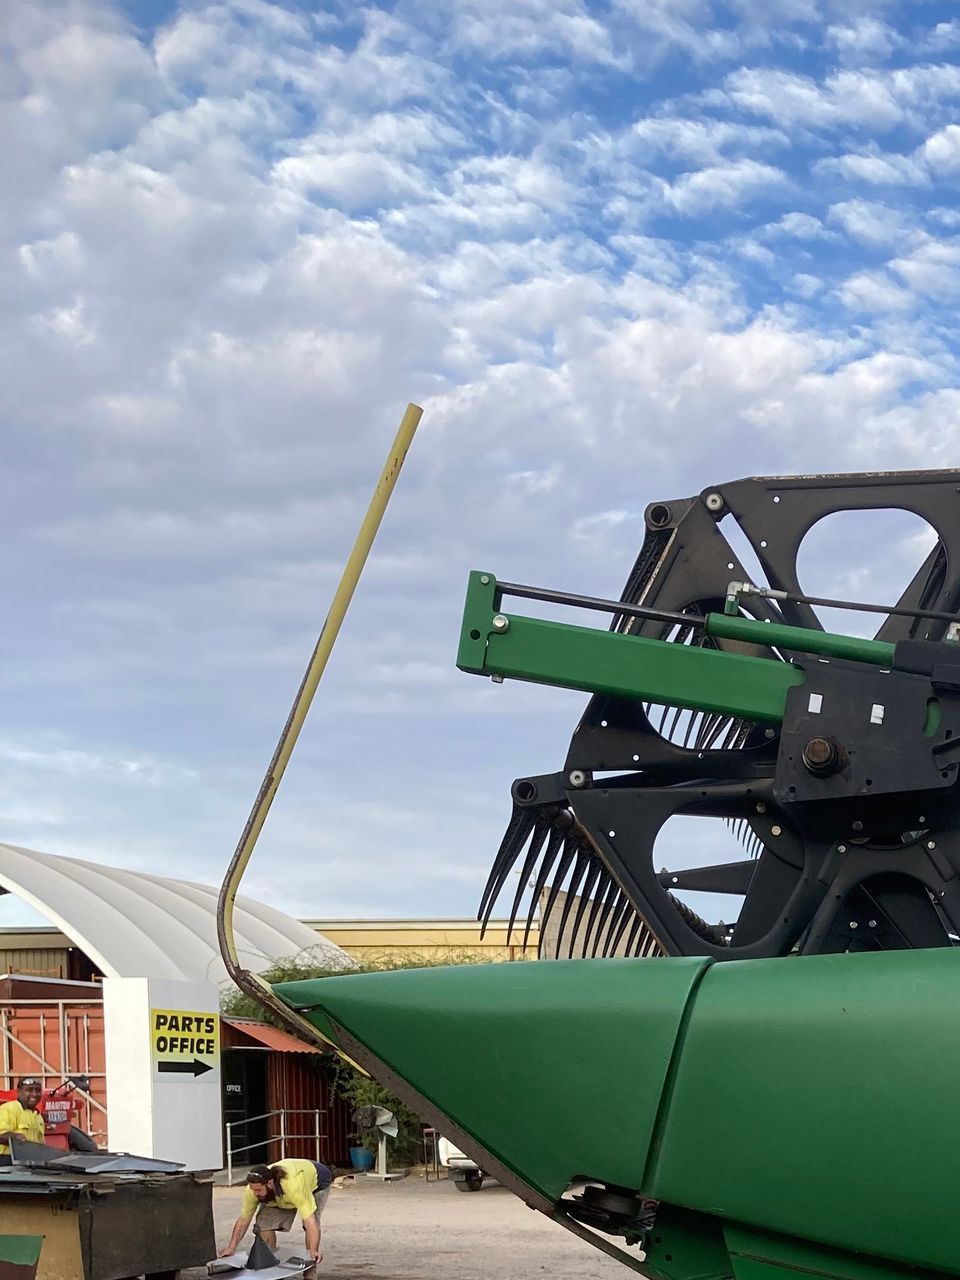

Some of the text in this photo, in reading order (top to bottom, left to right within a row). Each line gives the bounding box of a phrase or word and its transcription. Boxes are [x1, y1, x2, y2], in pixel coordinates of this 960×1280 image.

[155, 1014, 215, 1034] PARTS
[156, 1036, 215, 1055] OFFICE
[226, 1084, 241, 1093] OFFICE
